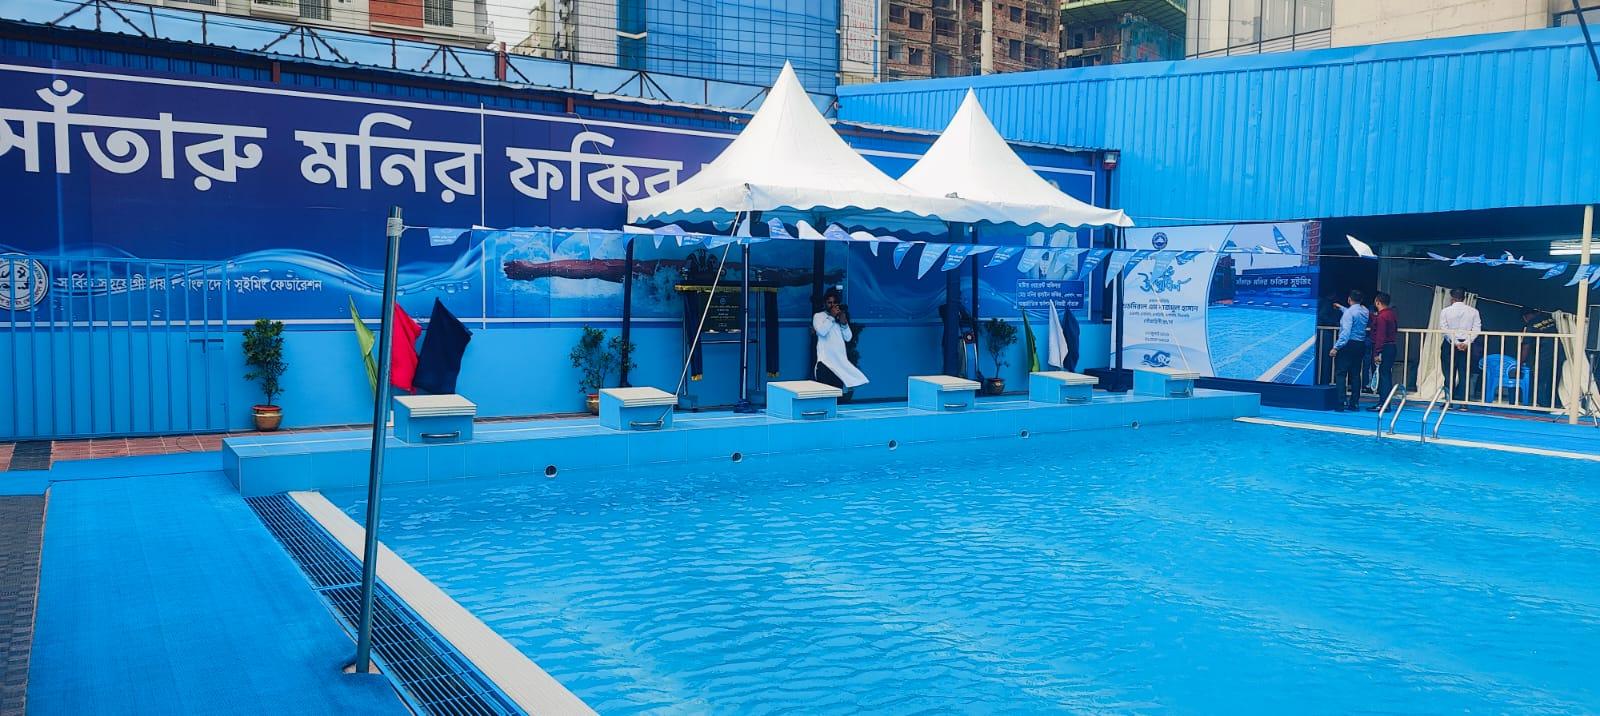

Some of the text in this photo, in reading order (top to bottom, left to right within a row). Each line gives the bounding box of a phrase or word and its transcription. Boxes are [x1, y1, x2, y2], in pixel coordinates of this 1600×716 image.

[0, 79, 268, 191] সাঁতারু
[294, 112, 482, 203] মনির
[180, 278, 230, 293] বাংলদে
[234, 275, 268, 294] সুইমিং
[270, 277, 322, 292] ফেডারেশন
